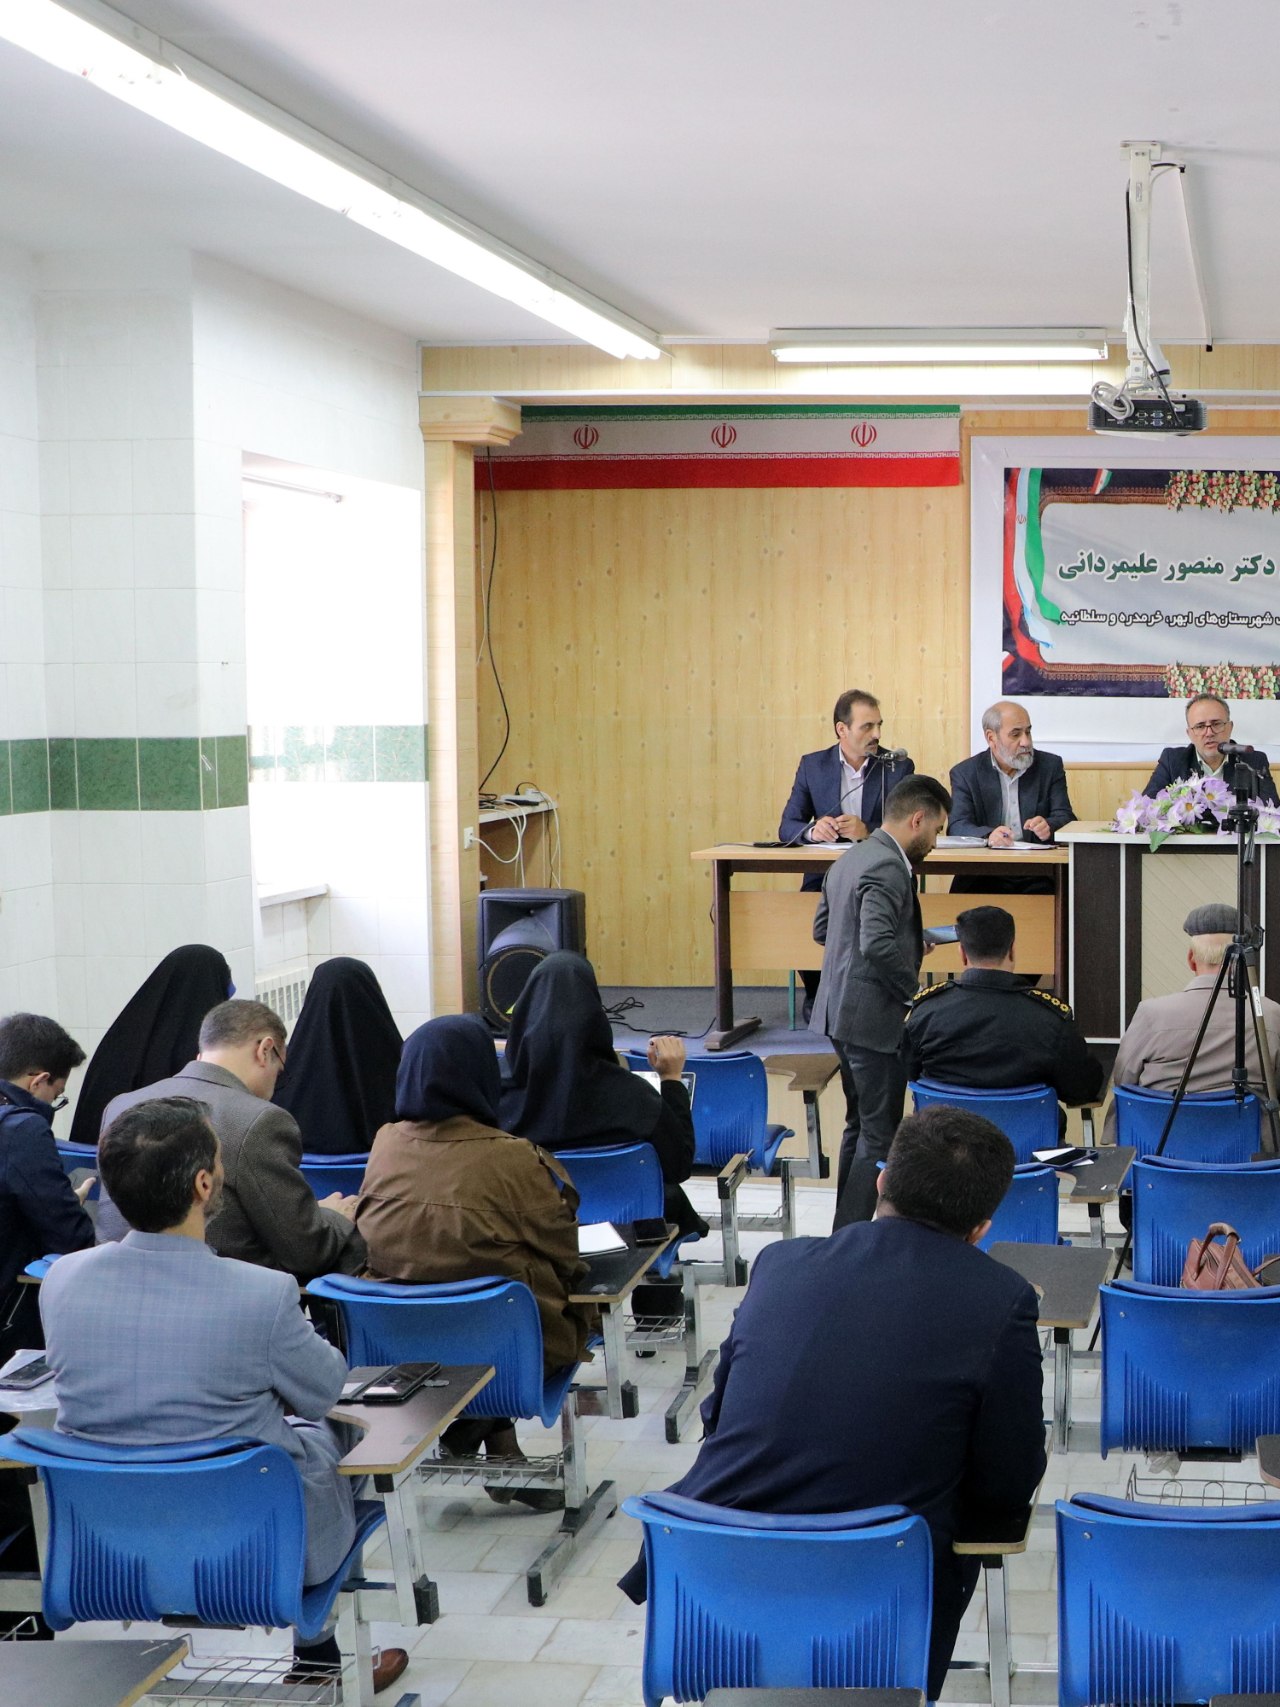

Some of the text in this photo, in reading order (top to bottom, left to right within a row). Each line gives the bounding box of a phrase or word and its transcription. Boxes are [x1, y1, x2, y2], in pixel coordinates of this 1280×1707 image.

[1058, 551, 1158, 580] علیمردانی
[1163, 556, 1224, 581] منصور
[1230, 554, 1275, 582] دکتر
[1060, 609, 1106, 626] سلطانیه
[1109, 613, 1117, 626] و
[1118, 611, 1163, 626] خرمدره
